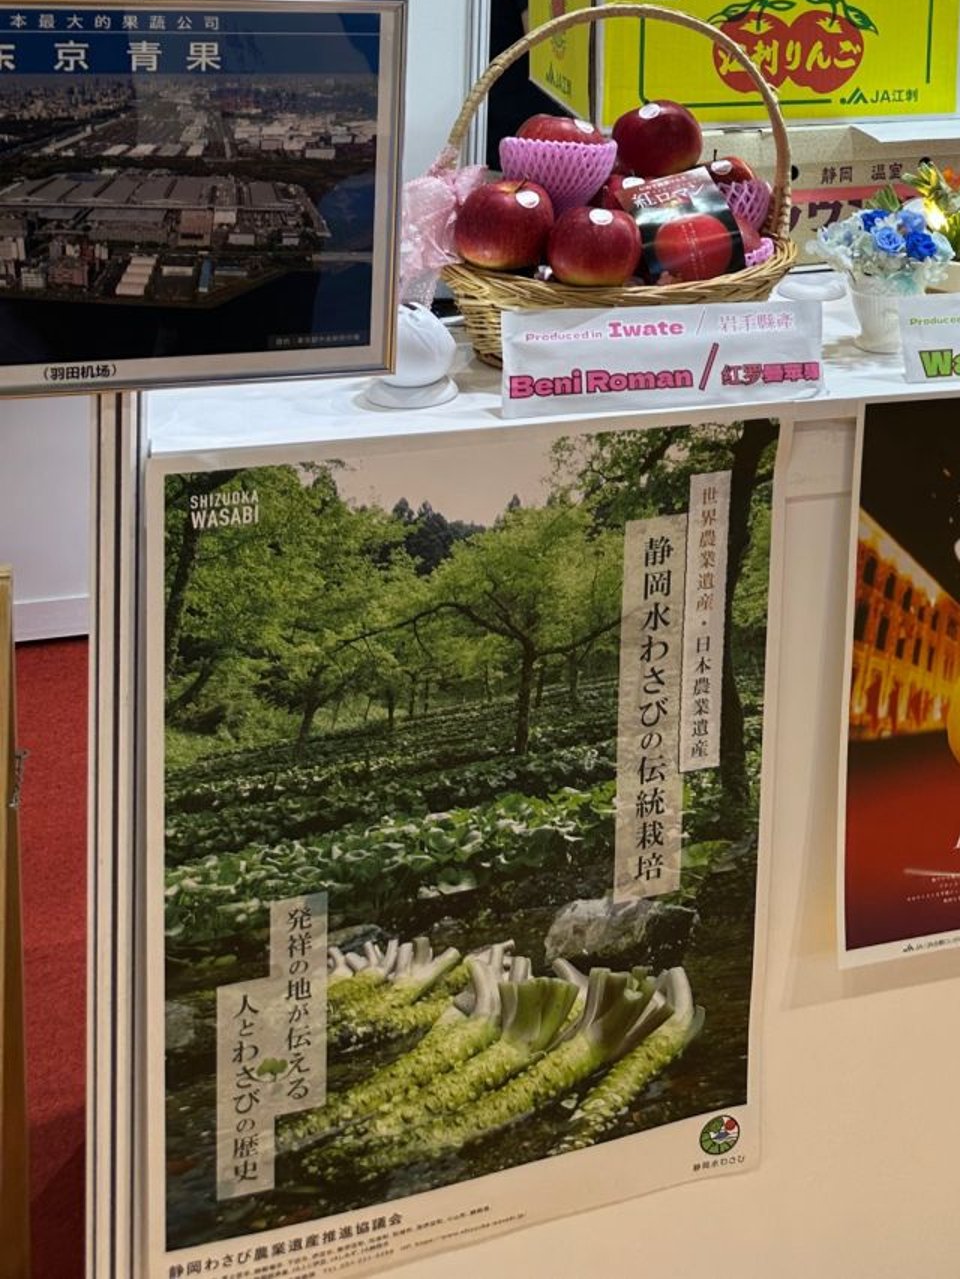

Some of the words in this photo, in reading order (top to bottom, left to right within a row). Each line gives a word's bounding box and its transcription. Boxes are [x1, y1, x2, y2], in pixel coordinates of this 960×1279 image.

[869, 88, 919, 105] JA江刺
[821, 166, 853, 185] 静岡
[871, 162, 903, 180] 温室
[525, 330, 587, 342] Produced
[608, 320, 684, 339] Iwate
[509, 368, 582, 400] Beni
[586, 368, 694, 395] Roman
[190, 489, 260, 510] SHIZUOKA
[191, 504, 260, 530] WASABI
[690, 487, 721, 758] 世界農業遺産・日本農業遺産
[633, 535, 675, 882] 静岡水わさびの伝統栽培
[285, 906, 313, 1101] 発祥の地が伝える
[230, 993, 260, 1182] 人とわさびの歴史
[168, 1211, 404, 1279] 静岡わさび農業遺産推進協議会
